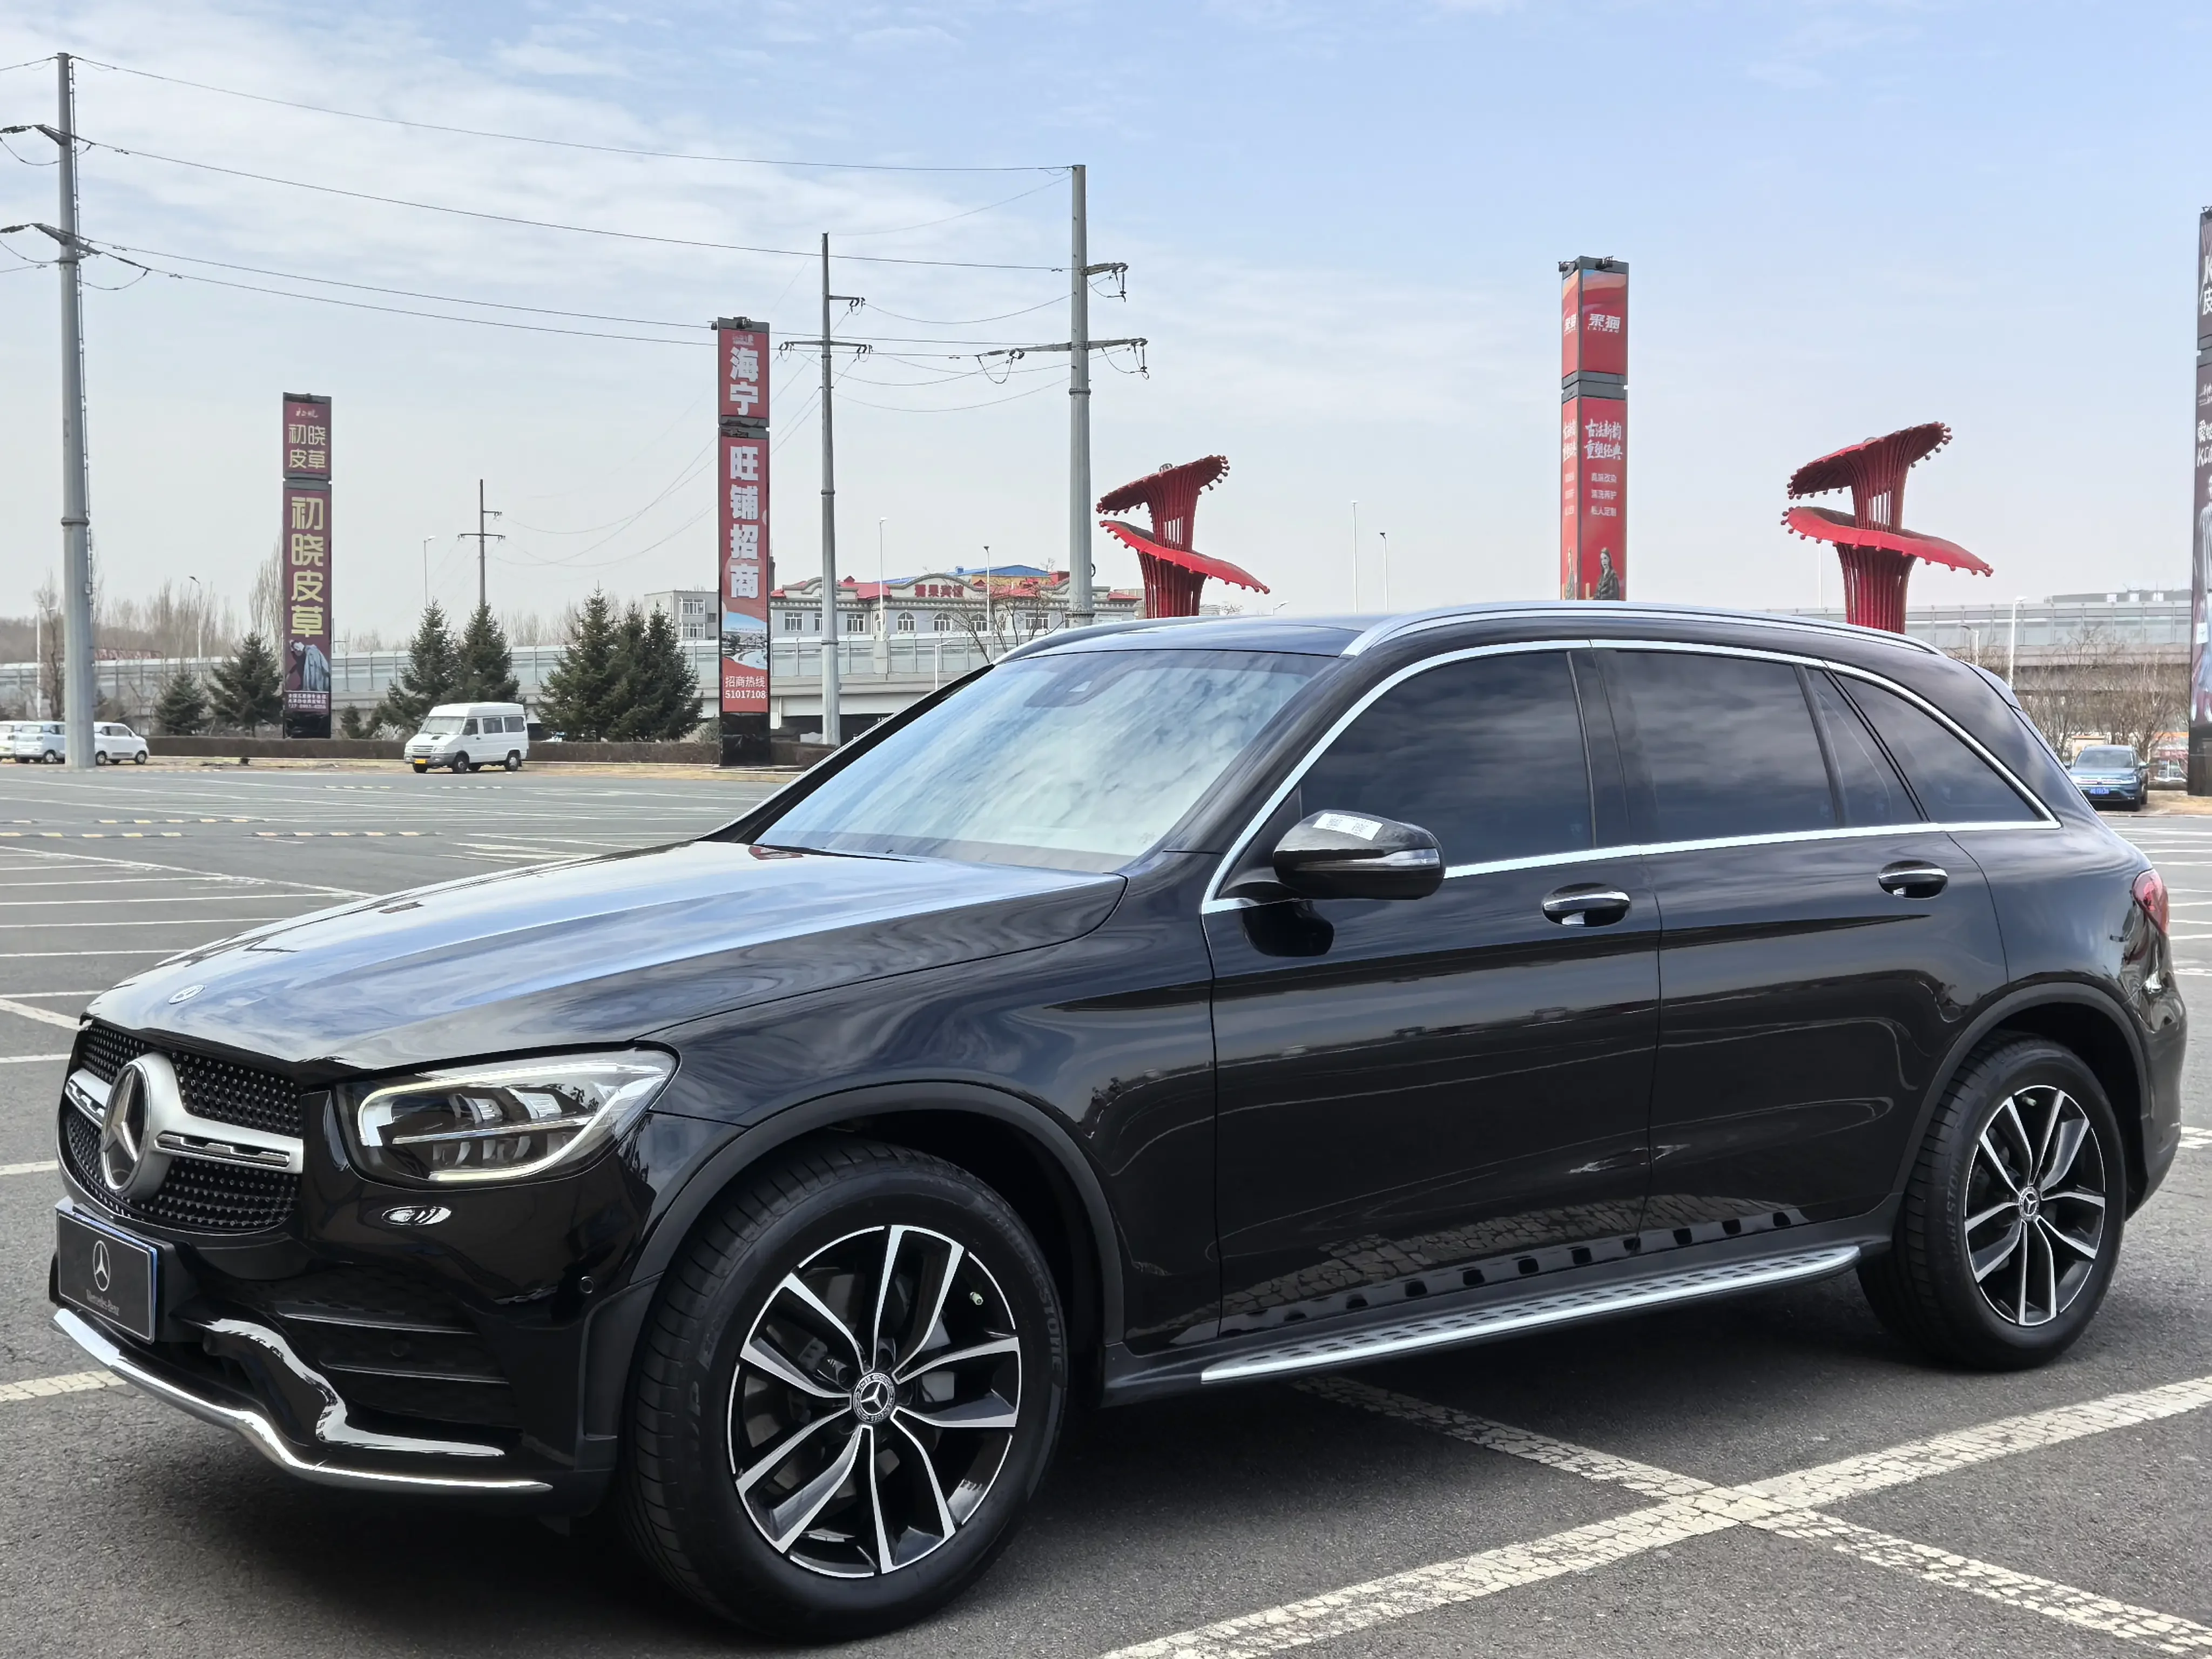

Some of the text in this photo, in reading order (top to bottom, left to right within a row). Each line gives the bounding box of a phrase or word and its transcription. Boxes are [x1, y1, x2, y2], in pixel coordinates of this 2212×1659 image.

[730, 346, 758, 415] 海宁
[288, 423, 326, 446] 初晓
[288, 448, 326, 469] 皮草
[1584, 439, 1623, 460] 重塑经典
[730, 446, 759, 599] 旺铺招商
[291, 496, 323, 638] 初晓皮草
[725, 675, 766, 688] 招商热线
[725, 690, 767, 699] 51017108
